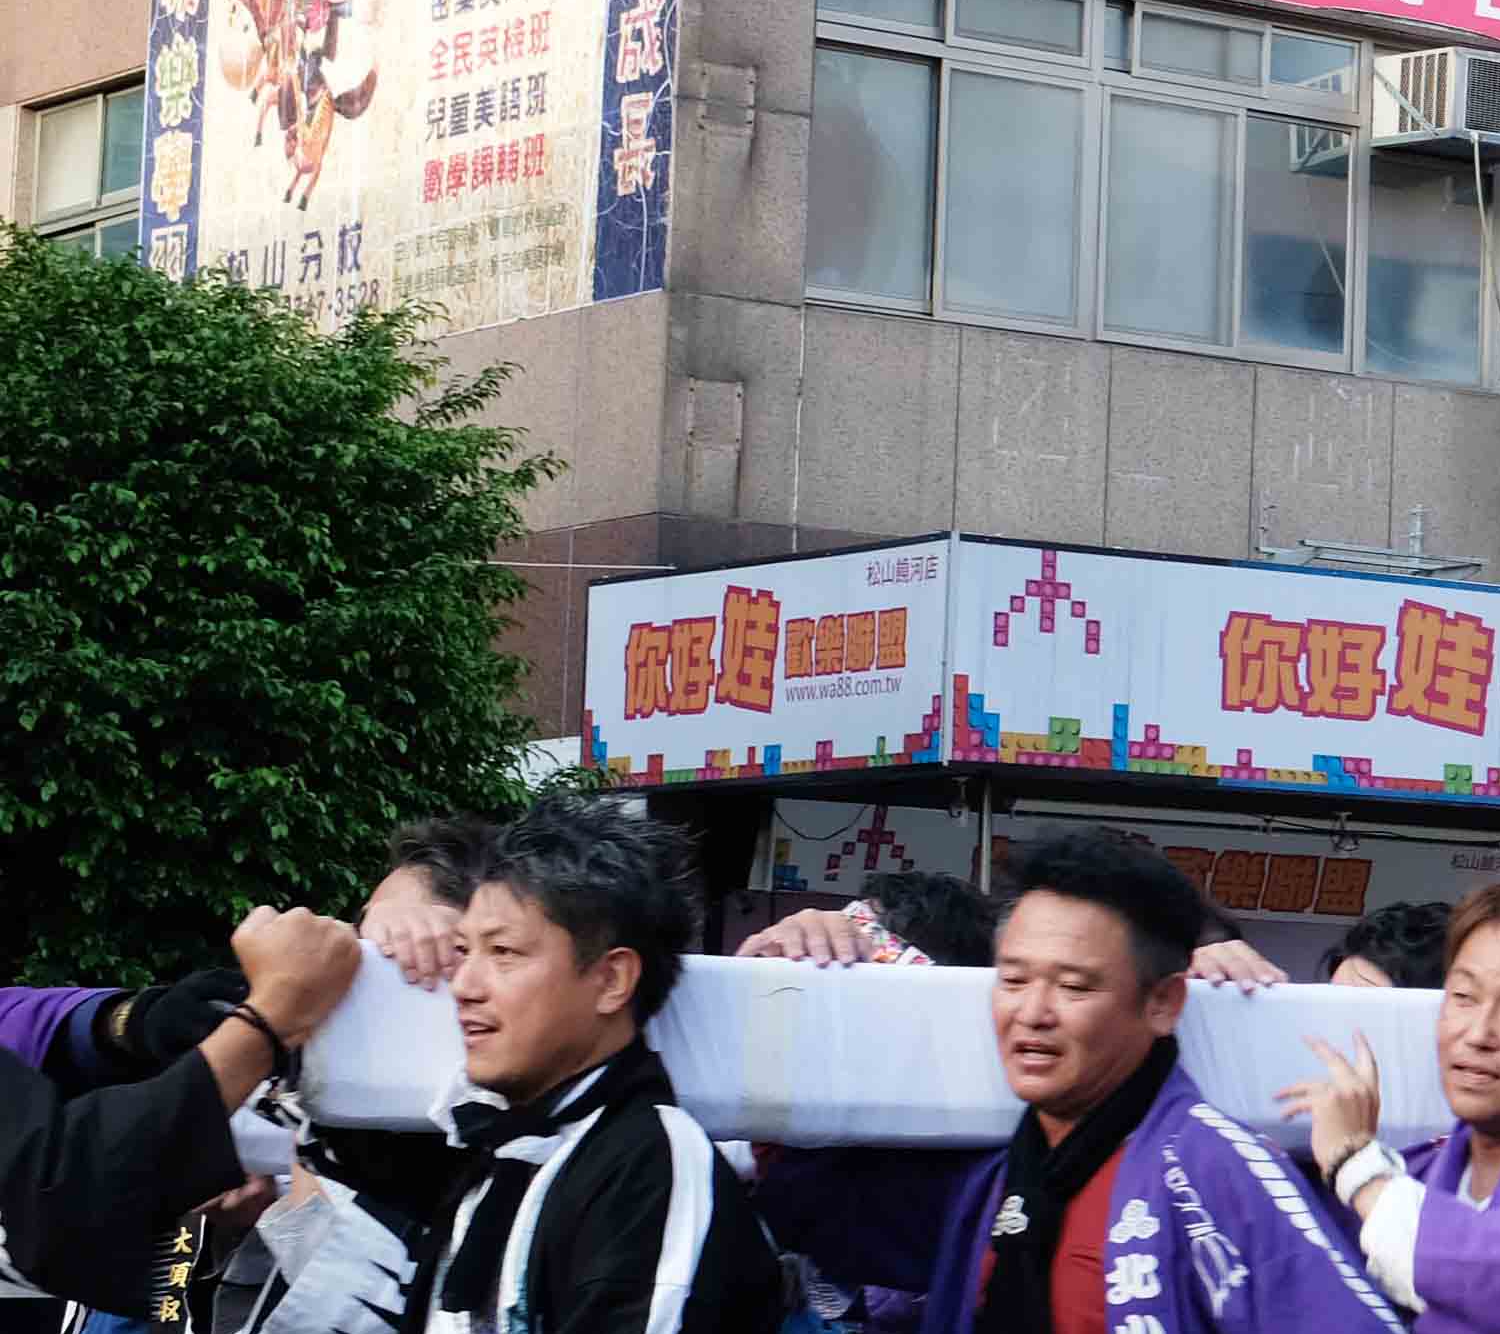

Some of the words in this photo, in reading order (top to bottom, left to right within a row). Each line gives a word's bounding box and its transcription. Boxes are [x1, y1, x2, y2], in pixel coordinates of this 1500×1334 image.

[425, 70, 548, 142] 兒童美語班
[623, 584, 782, 721] 你好娃
[784, 606, 908, 679] 歡樂聯盟
[784, 675, 903, 703] www.wa88.com.tw
[1219, 597, 1495, 737] 你好娃
